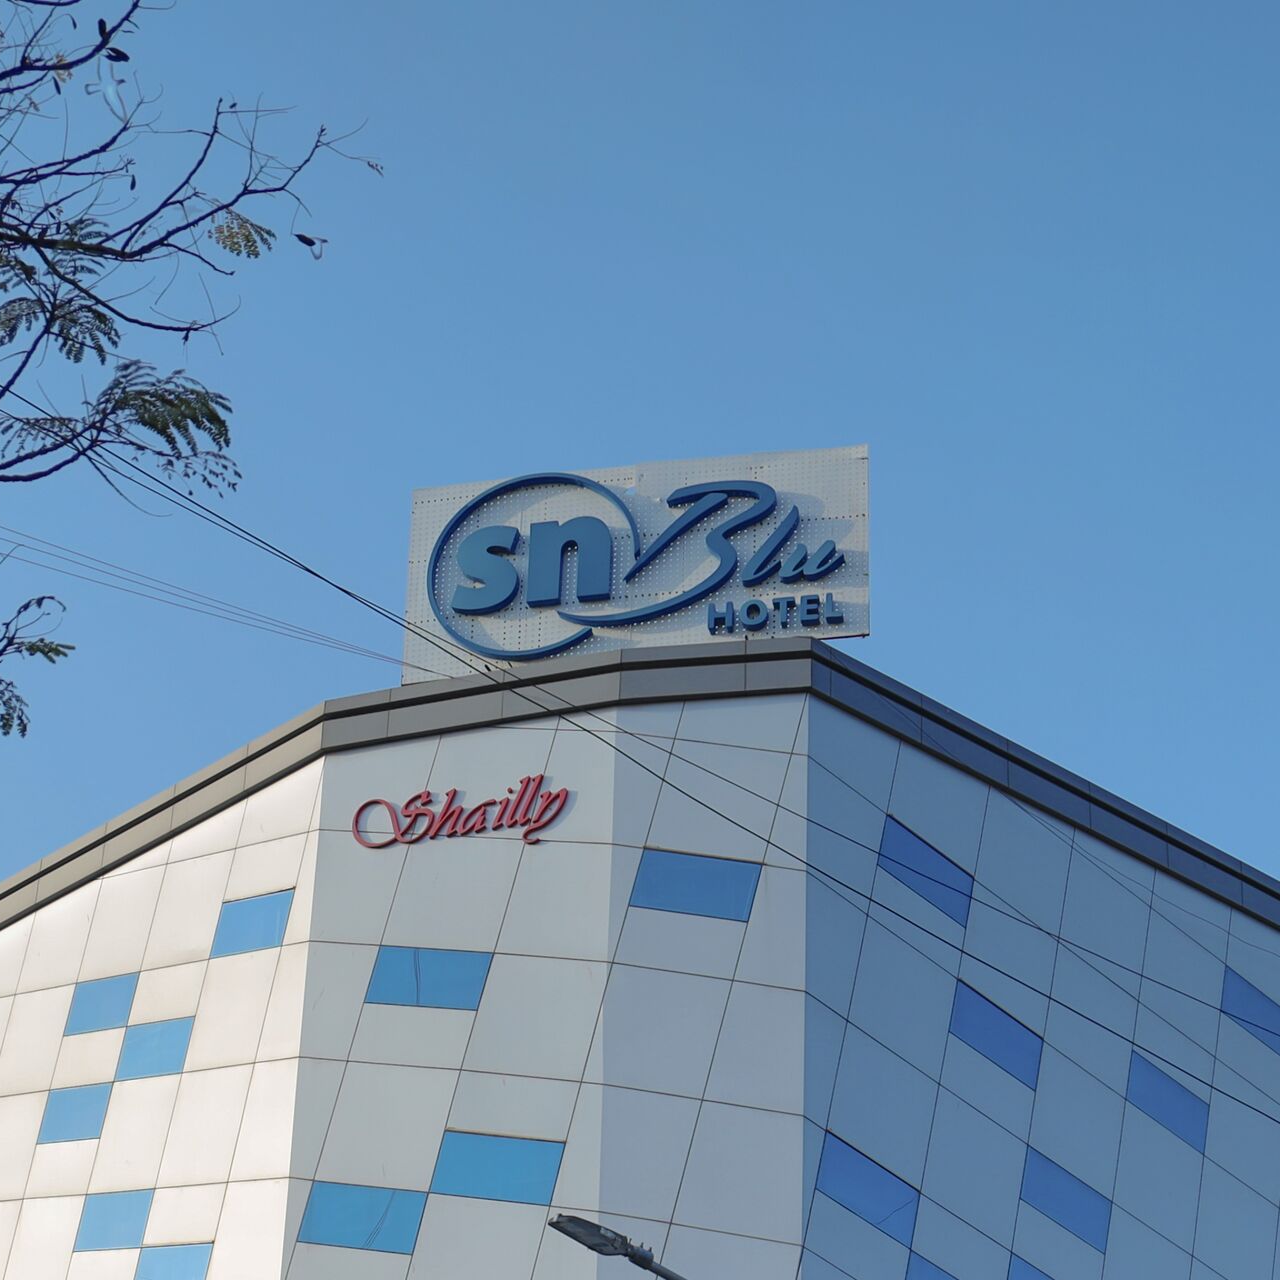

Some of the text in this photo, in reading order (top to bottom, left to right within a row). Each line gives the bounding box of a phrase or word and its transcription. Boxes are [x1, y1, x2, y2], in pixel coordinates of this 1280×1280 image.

[452, 480, 845, 627] sn Blu
[707, 593, 844, 635] HOTEL
[352, 774, 568, 848] Shailly
